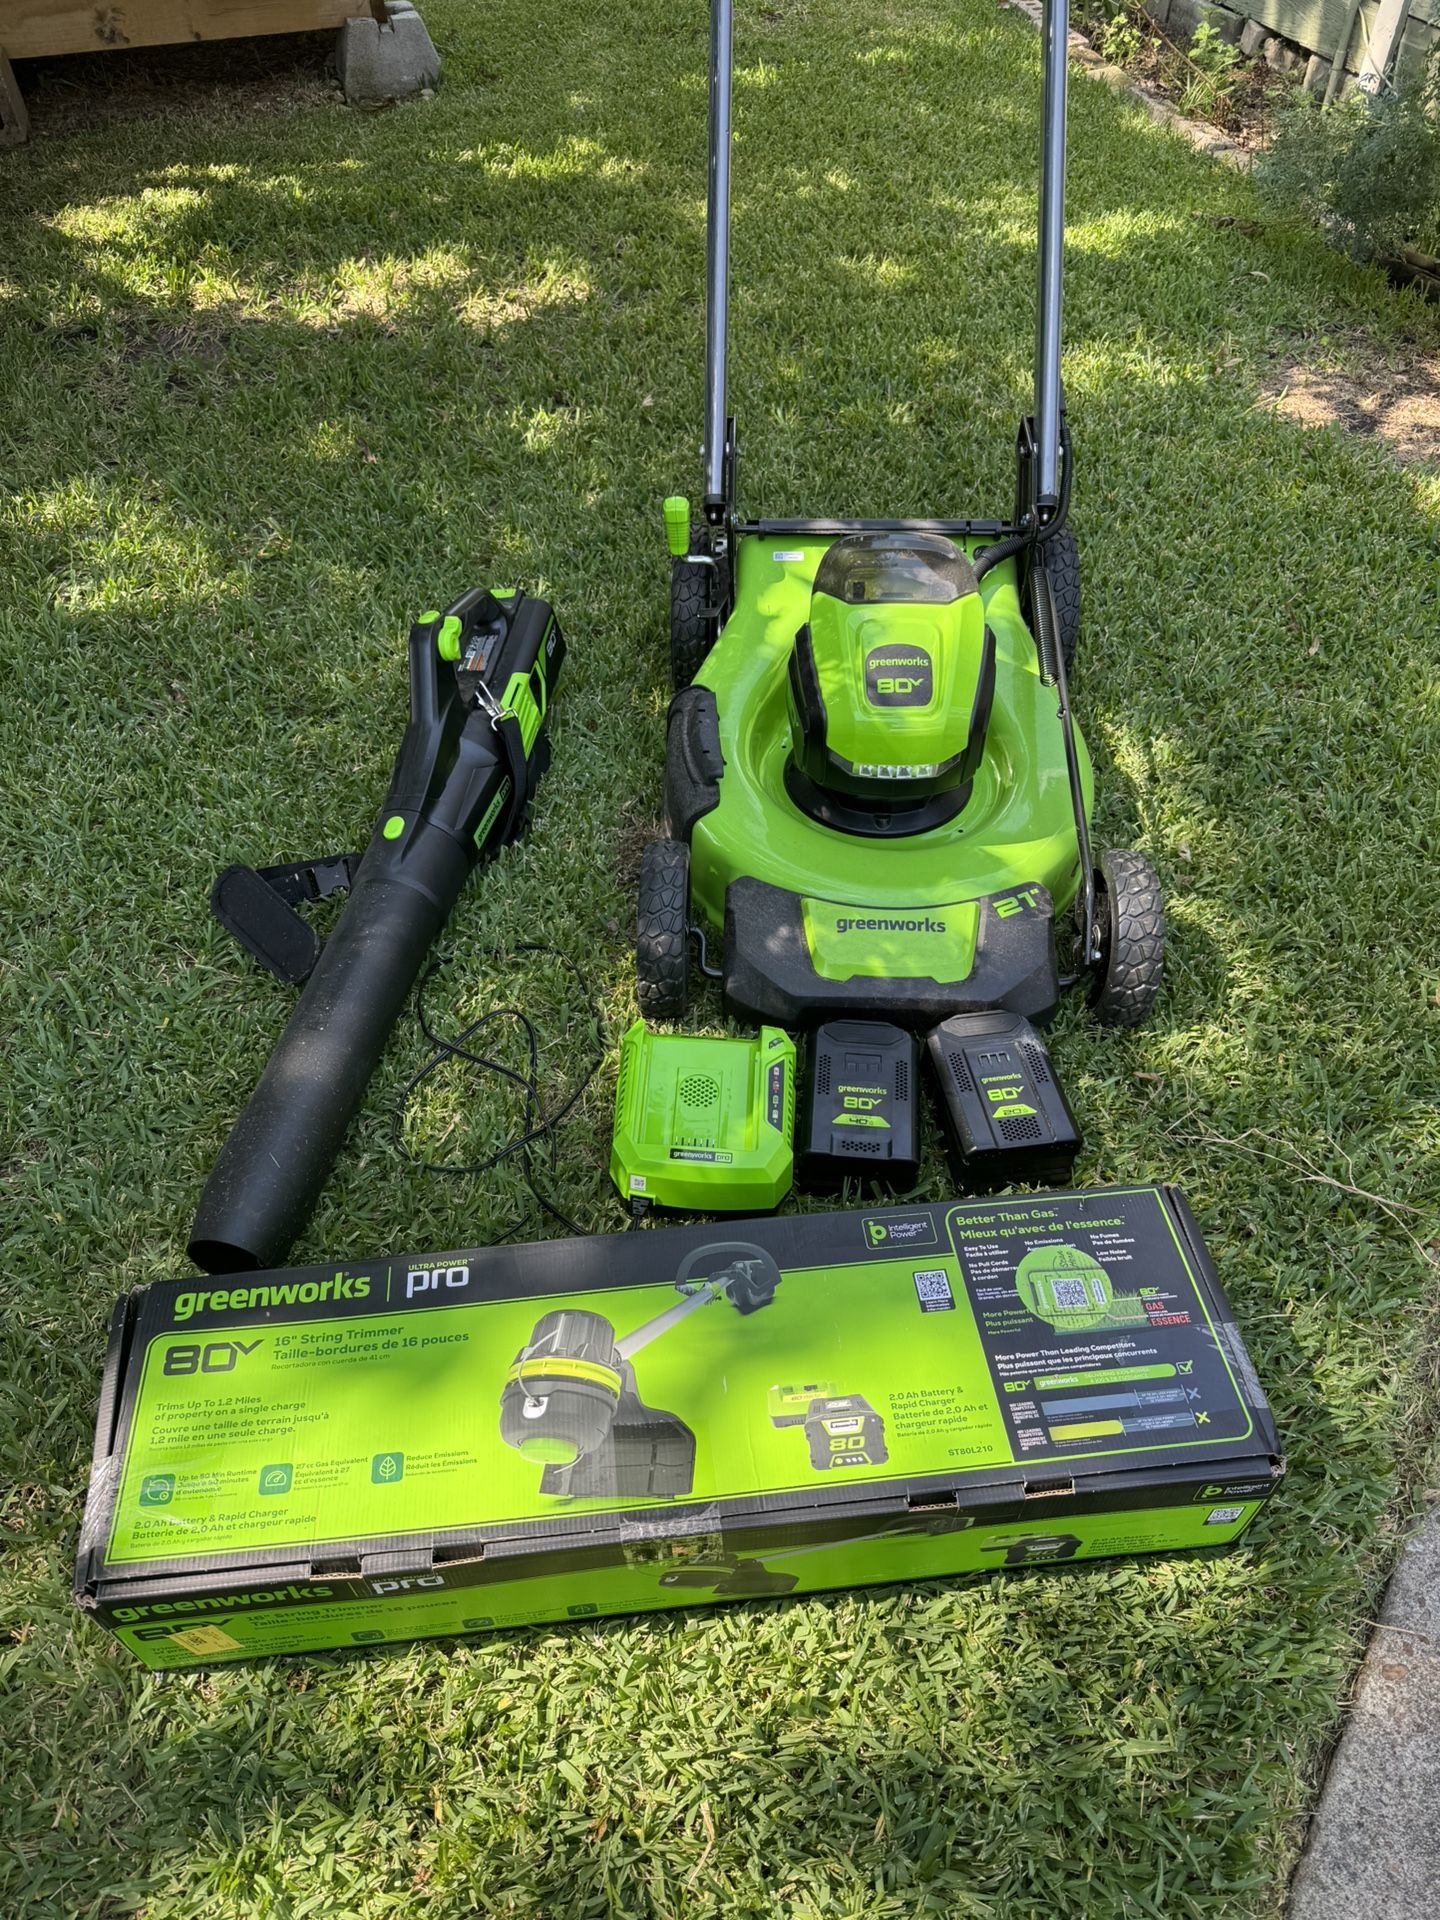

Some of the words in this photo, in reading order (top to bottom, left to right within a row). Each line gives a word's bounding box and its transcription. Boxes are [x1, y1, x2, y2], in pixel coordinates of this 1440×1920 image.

[869, 657, 928, 669] greenworks
[877, 678, 924, 693] 80V
[478, 800, 501, 842] greenworks
[501, 782, 509, 798] pro
[992, 888, 1040, 919] 21"
[836, 918, 946, 933] greenworks
[982, 1073, 1022, 1084] greenworks
[838, 1085, 887, 1094] greenworks
[987, 1086, 1024, 1101] 80V
[844, 1096, 882, 1110] 80V
[673, 1151, 712, 1160] greenworks
[956, 1214, 994, 1226] Better
[997, 1212, 1029, 1222] Than
[888, 1221, 928, 1232] Intelligent
[960, 1228, 998, 1239] Mieux
[1000, 1224, 1045, 1238] qu'avec
[1049, 1222, 1064, 1232] de
[1034, 1237, 1064, 1245] Emissions
[408, 1262, 435, 1271] ULTRA
[406, 1267, 469, 1298] pro
[174, 1272, 370, 1321] greenworks
[1140, 1286, 1159, 1295] 80V
[1146, 1301, 1164, 1310] GAS
[1002, 1317, 1034, 1327] puissant
[1151, 1315, 1191, 1326] ESSENCE
[275, 1336, 297, 1347] 16"
[300, 1331, 343, 1344] String
[346, 1326, 404, 1340] Trimmer
[273, 1343, 378, 1360] Taille-bordures
[382, 1339, 398, 1350] de
[401, 1337, 418, 1347] 16
[422, 1333, 469, 1348] pouces
[1015, 1351, 1039, 1360] Power
[1040, 1348, 1058, 1357] Than
[1060, 1346, 1090, 1356] Leading
[1090, 1342, 1136, 1353] Competitors
[163, 1338, 264, 1376] 80V
[1014, 1359, 1046, 1369] puissant
[1047, 1358, 1061, 1367] que
[1074, 1353, 1113, 1363] principaux
[1114, 1348, 1157, 1358] concurrents
[1004, 1379, 1031, 1392] 80V
[1039, 1376, 1079, 1387] greenworks
[889, 1392, 904, 1401] 2.0
[906, 1391, 918, 1399] Ah
[921, 1387, 955, 1398] Battery
[157, 1402, 184, 1410] Trims
[187, 1401, 201, 1409] Up
[218, 1398, 232, 1406] 1.2
[235, 1396, 261, 1404] Miles
[891, 1401, 917, 1411] Rapid
[919, 1397, 955, 1407] Charger
[167, 1410, 212, 1421] property
[239, 1405, 268, 1414] single
[271, 1402, 306, 1412] charge
[893, 1410, 930, 1420] Batterie
[932, 1408, 944, 1416] de
[152, 1424, 189, 1434] Couvre
[214, 1420, 238, 1430] taille
[241, 1419, 253, 1427] de
[257, 1416, 290, 1425] terrain
[293, 1412, 329, 1424] jusqu'à
[896, 1420, 936, 1430] chargeur
[938, 1416, 967, 1425] rapide
[168, 1434, 189, 1444] mile
[207, 1432, 226, 1440] une
[229, 1429, 256, 1438] seule
[258, 1426, 295, 1436] charge.
[830, 1436, 865, 1451] 80
[948, 1445, 993, 1456] ST80L210
[435, 1450, 468, 1458] Emissions
[331, 1457, 368, 1466] Equivalent
[406, 1462, 429, 1470] Réduit
[295, 1468, 332, 1477] Équivalent
[304, 1476, 338, 1484] d'essence
[1226, 1483, 1270, 1491] Intelligent
[135, 1521, 152, 1529] 2.0
[154, 1519, 167, 1527] Ah
[209, 1514, 215, 1522] &
[218, 1512, 246, 1522] Rapid
[248, 1508, 288, 1519] Charger
[132, 1530, 174, 1540] Batterie
[176, 1528, 188, 1536] de
[211, 1524, 224, 1532] Ah
[239, 1518, 283, 1530] chargeur
[285, 1515, 316, 1526] rapide
[372, 1576, 444, 1594] pro
[112, 1586, 333, 1622] greenworks
[323, 1604, 384, 1612] Trimmer
